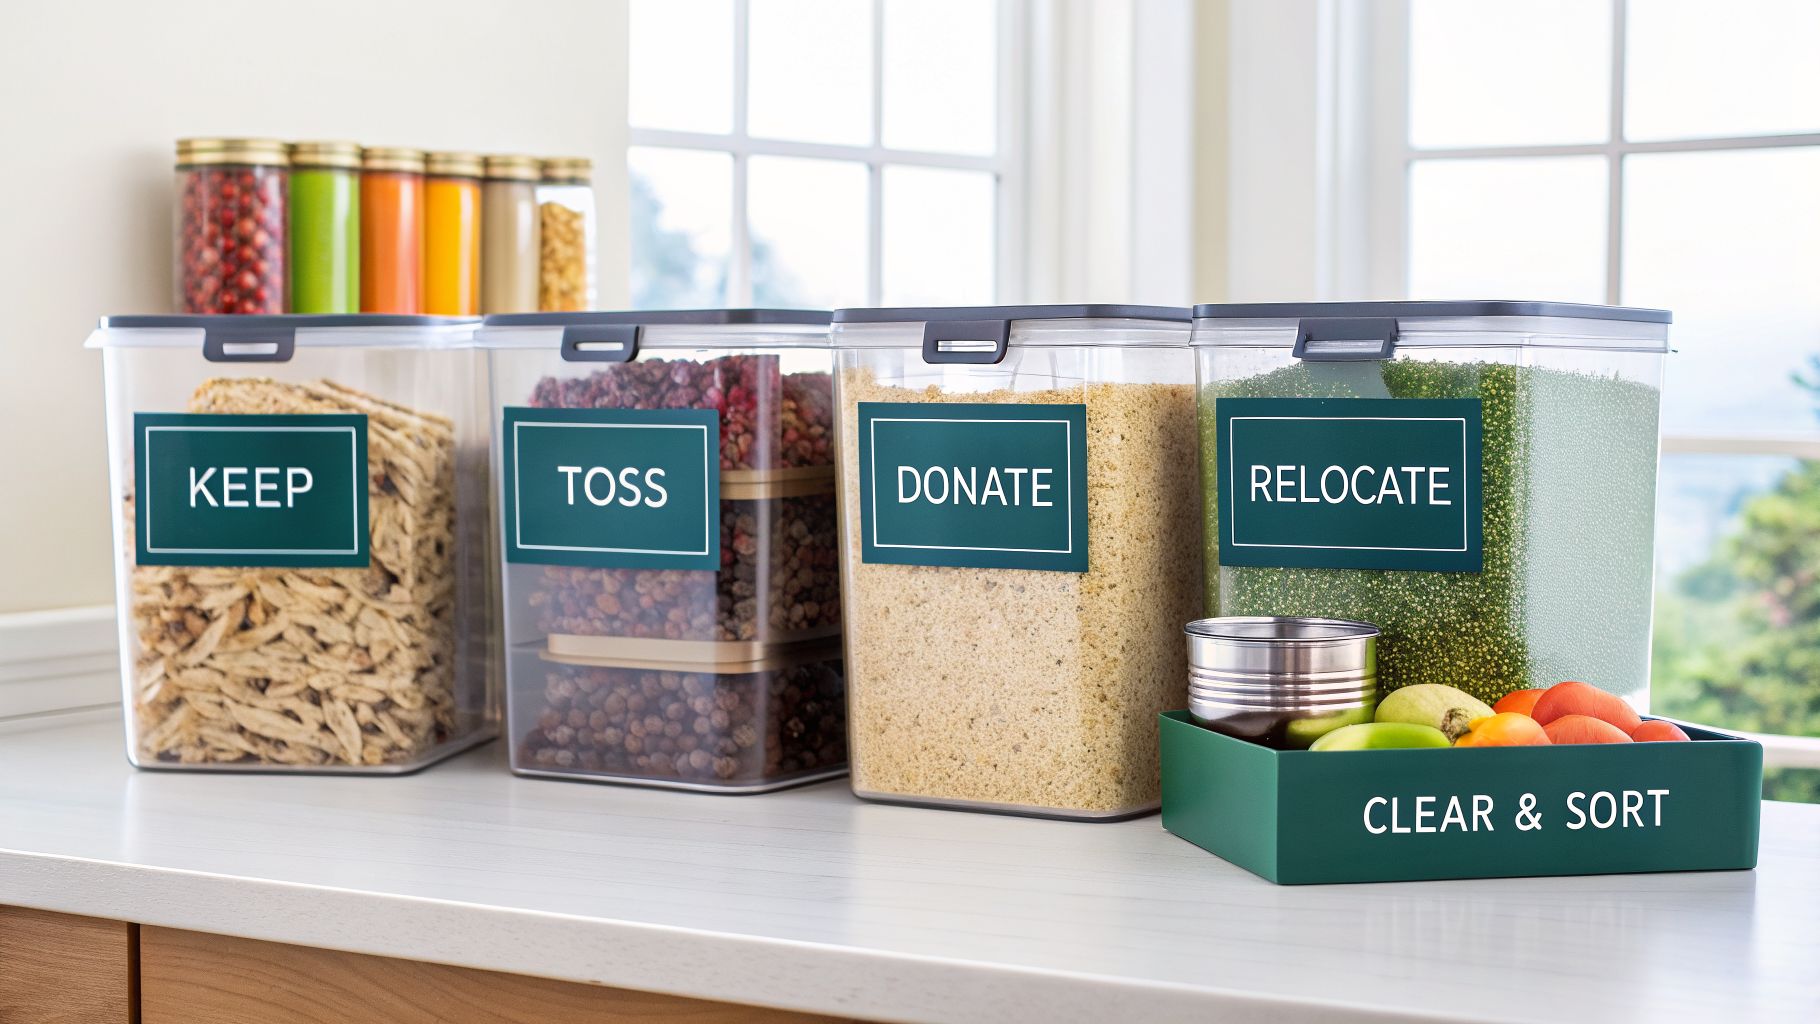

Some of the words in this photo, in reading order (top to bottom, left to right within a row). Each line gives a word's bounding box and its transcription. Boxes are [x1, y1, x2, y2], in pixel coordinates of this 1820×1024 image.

[189, 466, 313, 508] KEEP
[557, 465, 668, 508] TOSS
[897, 465, 1054, 507] DONATE
[1251, 464, 1452, 506] RELOCATE
[1363, 794, 1495, 835] CLEAR
[1514, 792, 1543, 832] &
[1566, 789, 1670, 830] SORT
